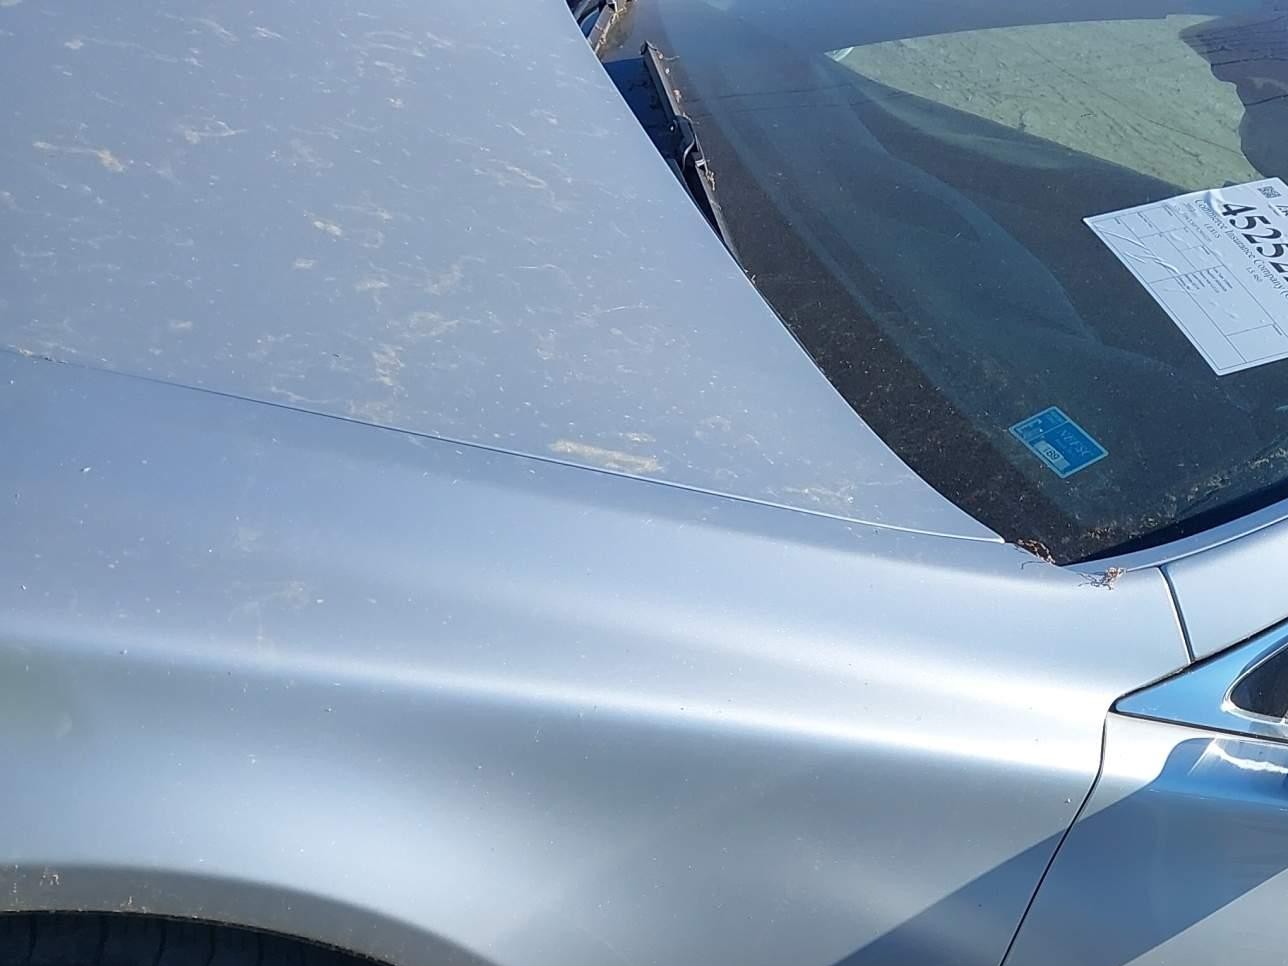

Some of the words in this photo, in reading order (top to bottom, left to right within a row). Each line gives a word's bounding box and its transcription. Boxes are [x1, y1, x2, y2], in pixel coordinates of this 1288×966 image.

[1194, 199, 1228, 230] Commerce
[1225, 229, 1257, 259] Insurance
[1252, 259, 1286, 290] Company
